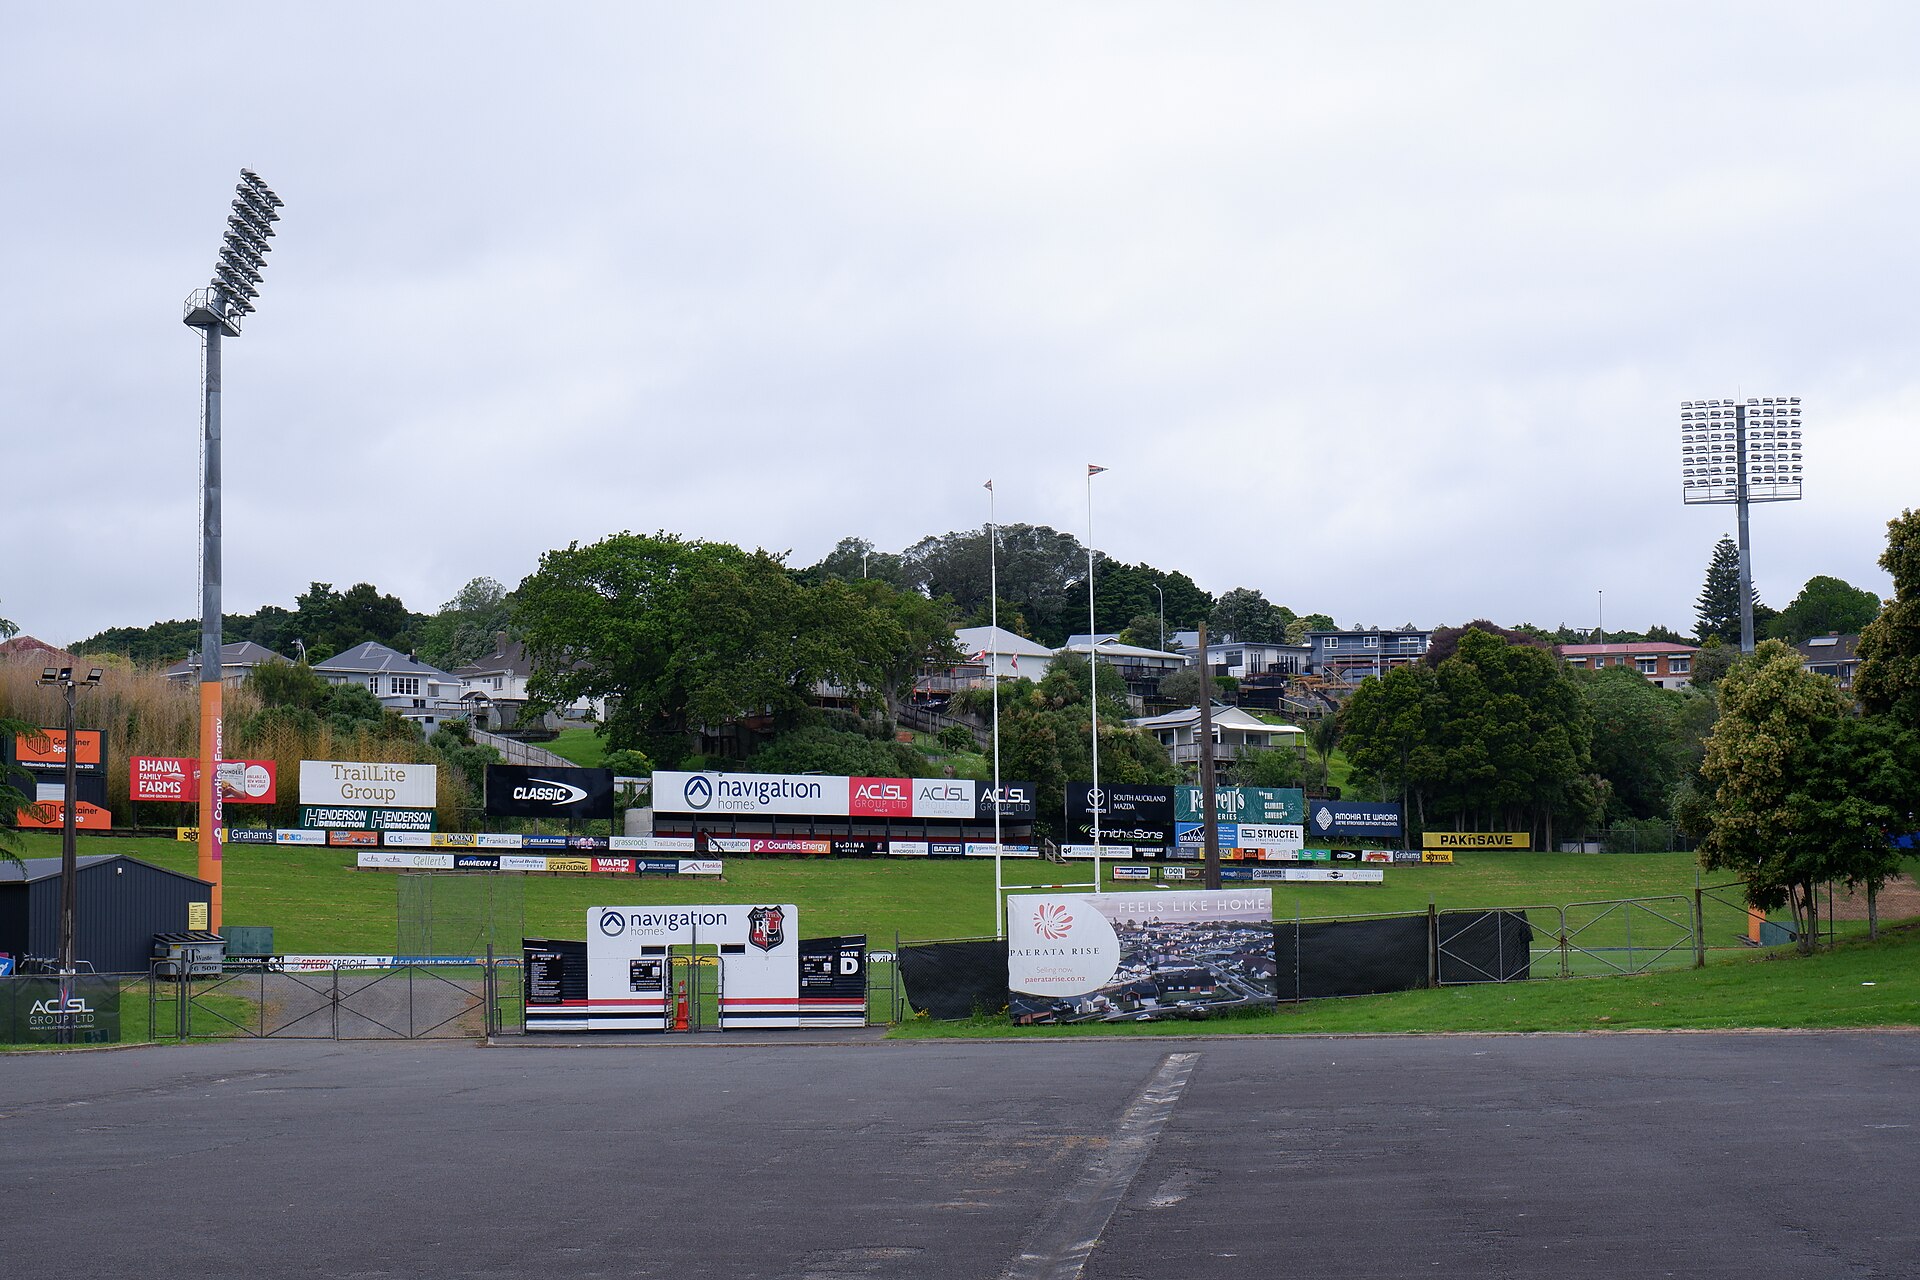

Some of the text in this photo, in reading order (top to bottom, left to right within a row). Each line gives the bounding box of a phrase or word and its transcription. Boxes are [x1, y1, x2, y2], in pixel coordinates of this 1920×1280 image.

[139, 760, 182, 773] BHANA
[332, 764, 406, 782] TrailLite
[139, 781, 181, 793] FARMS
[718, 778, 820, 804] navigation
[341, 784, 396, 804] Group
[513, 787, 566, 800] CLASSIC
[1134, 794, 1166, 802] AUCKLAND
[718, 798, 754, 810] homes
[854, 800, 907, 809] GROUP LTD
[1190, 788, 1244, 812] Farell's
[918, 801, 970, 810] GROUP LTD
[1015, 804, 1030, 812] LTD
[1335, 812, 1361, 820] AMOHIA
[232, 830, 272, 839] Grahams
[1258, 830, 1299, 839] STRUCTEL
[719, 840, 749, 848] navigation
[768, 840, 827, 852] Counties Energy
[1119, 899, 1271, 913] FEELS LIKE HOME.
[630, 910, 727, 931] navigation
[630, 927, 664, 936] homes
[1010, 948, 1100, 958] PAERATA RISE
[300, 959, 331, 969] SPEEDY
[840, 958, 858, 975] D
[1024, 976, 1085, 984] paeratarise.co.nz
[30, 1014, 94, 1024] GROUP LTD
